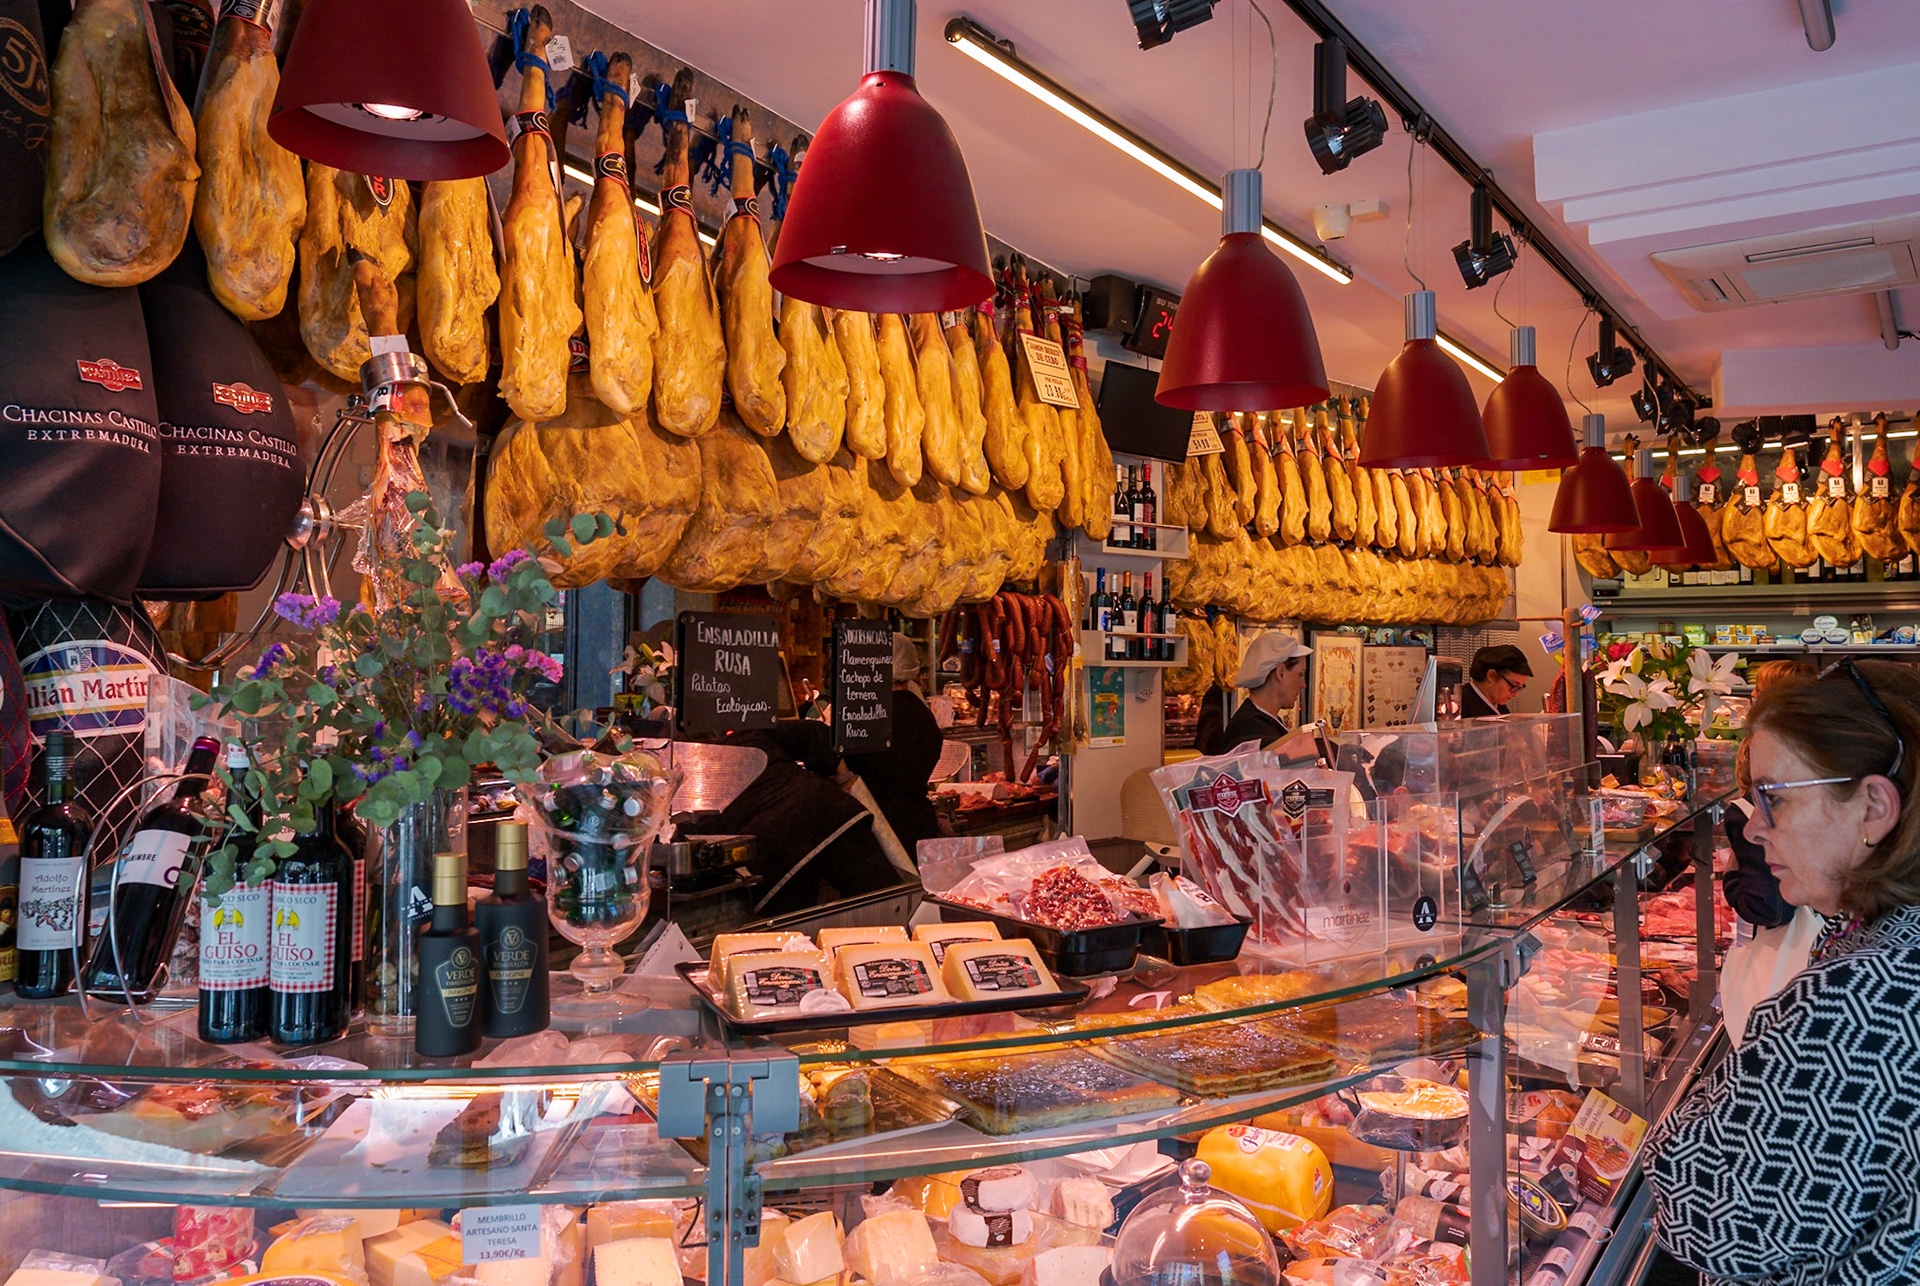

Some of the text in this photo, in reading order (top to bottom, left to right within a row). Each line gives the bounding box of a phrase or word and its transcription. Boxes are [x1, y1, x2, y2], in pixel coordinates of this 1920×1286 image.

[3, 404, 157, 439] CHACINAS CASTILLO
[27, 429, 150, 453] EXTREMADURA
[159, 422, 297, 456] CHACINAS CASTILLO
[177, 444, 291, 469] EXTREMADURA
[697, 621, 779, 648] ENSALADILLA
[714, 649, 751, 676] RUSA
[691, 673, 731, 693] Patatas
[873, 671, 884, 683] de
[846, 687, 878, 700] ternera
[846, 723, 868, 738] Rusa
[35, 874, 68, 884] Adolfo
[238, 894, 260, 902] SECO
[218, 932, 240, 945] EL
[278, 933, 297, 946] EL
[204, 944, 258, 959] GUISO
[493, 950, 531, 961] VERDE
[445, 968, 476, 980] VERDE
[478, 1213, 526, 1224] MEMBRILLO
[466, 1224, 537, 1236] ARTESANO SANTA
[487, 1237, 517, 1246] TERESA
[480, 1248, 525, 1260] 13,90€/Kg
